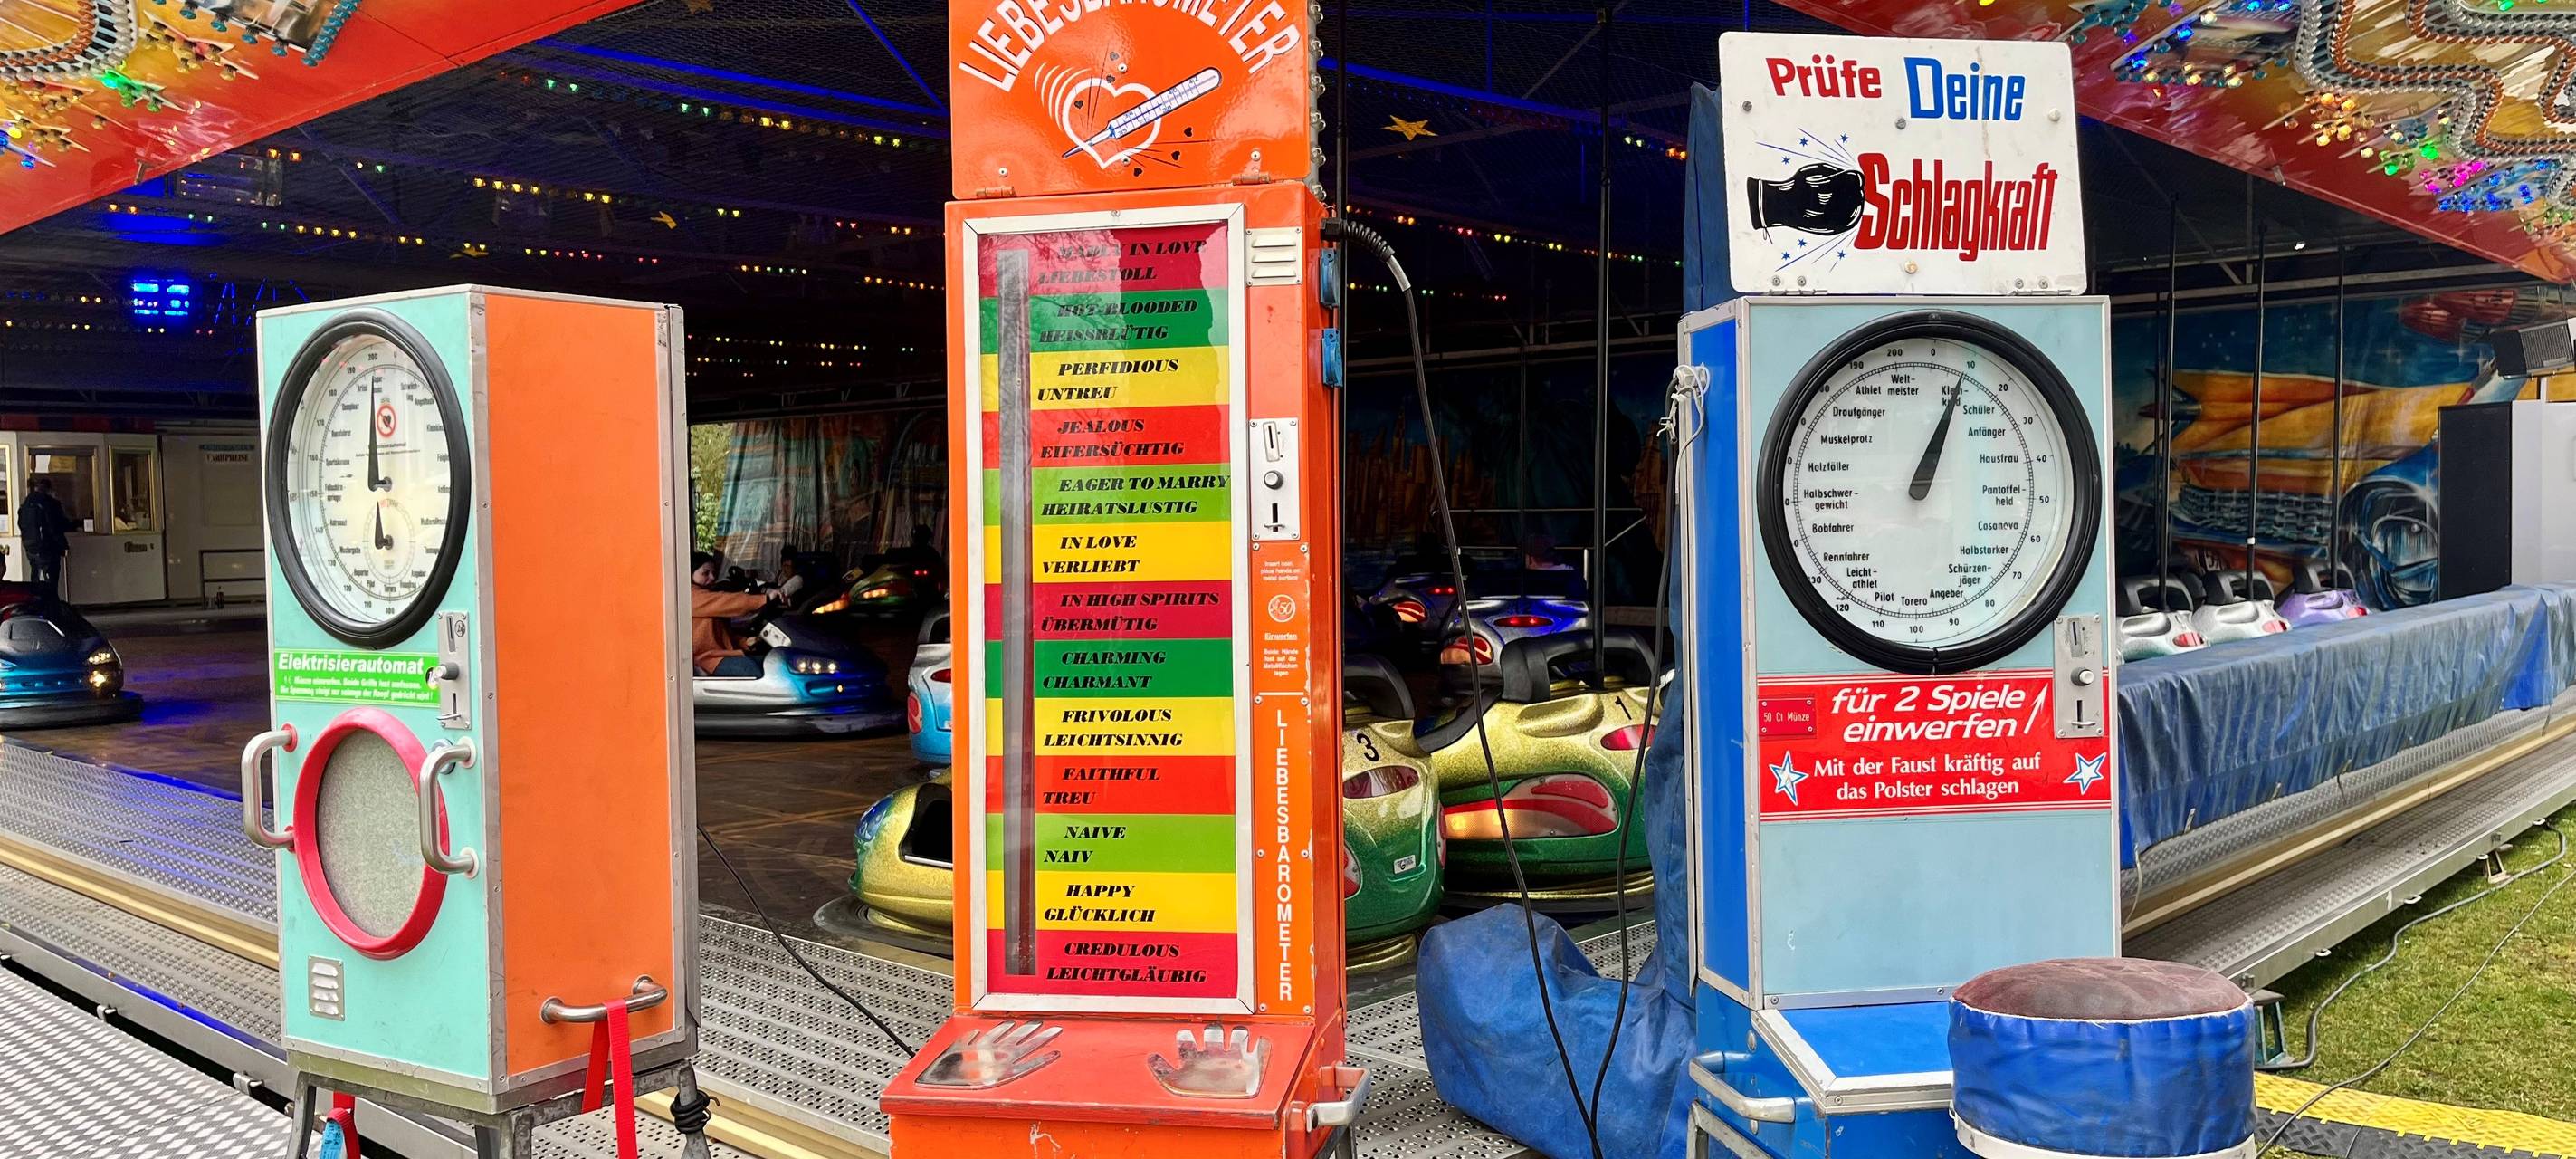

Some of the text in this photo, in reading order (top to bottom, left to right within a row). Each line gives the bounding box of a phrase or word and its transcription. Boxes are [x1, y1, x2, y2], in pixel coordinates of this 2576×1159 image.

[1765, 54, 2026, 120] Prüfe Deine
[1853, 153, 2057, 262] Schlagkraft
[1129, 242, 1153, 256] IN
[1155, 240, 1207, 254] LOVE
[1038, 267, 1157, 284] LIEBESTOLL
[1057, 300, 1197, 318] HOT-BLOODED
[1039, 323, 1168, 343] HEISSBLÜTIG
[1886, 349, 1903, 357] 200
[1057, 359, 1178, 376] PERFIDIOUS
[1966, 360, 1976, 369] 10
[1891, 374, 1915, 384] Welt-
[1036, 387, 1118, 401] UNTREU
[1856, 385, 1882, 395] Athlet
[1887, 387, 1919, 396] meister
[1999, 384, 2008, 392] 20
[1833, 407, 1885, 419] Draufgänger
[1963, 404, 1995, 415] Schüler
[1057, 419, 1144, 435] JEALOUS
[2023, 417, 2033, 425] 30
[1968, 426, 2006, 439] Anfänger
[1820, 434, 1873, 445] Muskelprotz
[1039, 438, 1184, 459] EIFERSÜCHTIG
[1980, 453, 2018, 463] Hausfrau
[2036, 455, 2047, 463] 40
[1808, 462, 1850, 473] Holzfäller
[1059, 475, 1230, 492] EAGER TO MARRY
[1982, 484, 2027, 495] Pantoffel-
[1804, 489, 1859, 499] Halbschwer-
[2038, 495, 2050, 503] 50
[1815, 500, 1848, 512] gewicht
[1995, 496, 2014, 505] held
[1040, 501, 1197, 516] HEIRATSLUSTIG
[1812, 522, 1854, 533] Bobfahrer
[1978, 521, 2018, 531] Casanova
[1059, 535, 1137, 549] IN LOVE
[2030, 535, 2041, 543] 60
[1960, 545, 2008, 555] Halbstarker
[1823, 552, 1870, 562] Rennfahrer
[1042, 560, 1140, 574] VERLIEBT
[1846, 567, 1878, 578] Leicht-
[1948, 563, 1992, 574] Schürzen-
[1958, 575, 1980, 588] jäger
[2012, 571, 2022, 580] 70
[1852, 579, 1878, 589] athlet
[1060, 592, 1219, 608] IN HIGH SPIRITS
[1875, 591, 1894, 602] Pilot
[1929, 589, 1964, 600] Angeber
[1901, 596, 1928, 606] Torero
[1985, 599, 1995, 608] 80
[1836, 604, 1850, 612] 120
[1041, 616, 1158, 632] ÜBERMÜTIG
[1872, 620, 1884, 628] 110
[1949, 618, 1960, 626] 90
[1909, 626, 1924, 634] 100
[279, 653, 425, 675] Elektrisierautomat
[1061, 651, 1167, 665] CHARMING
[1042, 675, 1152, 688] CHARMANT
[1831, 683, 2027, 714] für 2 Spiele
[1615, 696, 1632, 721] 1
[1061, 709, 1172, 723] FRIVOLOUS
[1763, 713, 1772, 723] 50
[1787, 711, 1809, 722] Münze
[1843, 712, 2017, 743] einwerfen
[1044, 733, 1183, 747] LEICHTSINNIG
[1356, 733, 1379, 762] 3
[1814, 752, 2042, 778] Mit der Faust kräftig auf
[1061, 767, 1160, 781] FAITHFUL
[1837, 778, 2019, 800] das Polster schlagen
[1043, 791, 1096, 805] TREU
[1064, 826, 1126, 839] NAIVE
[1044, 850, 1093, 863] NAIV
[1276, 709, 1293, 1001] LIEBESBAROMETER
[1065, 885, 1135, 897] HAPPY
[1044, 905, 1156, 923] GLÜCKLICH
[1064, 943, 1180, 957] CREDULOUS
[1045, 966, 1207, 983] LEICHTGLÄUBIG
